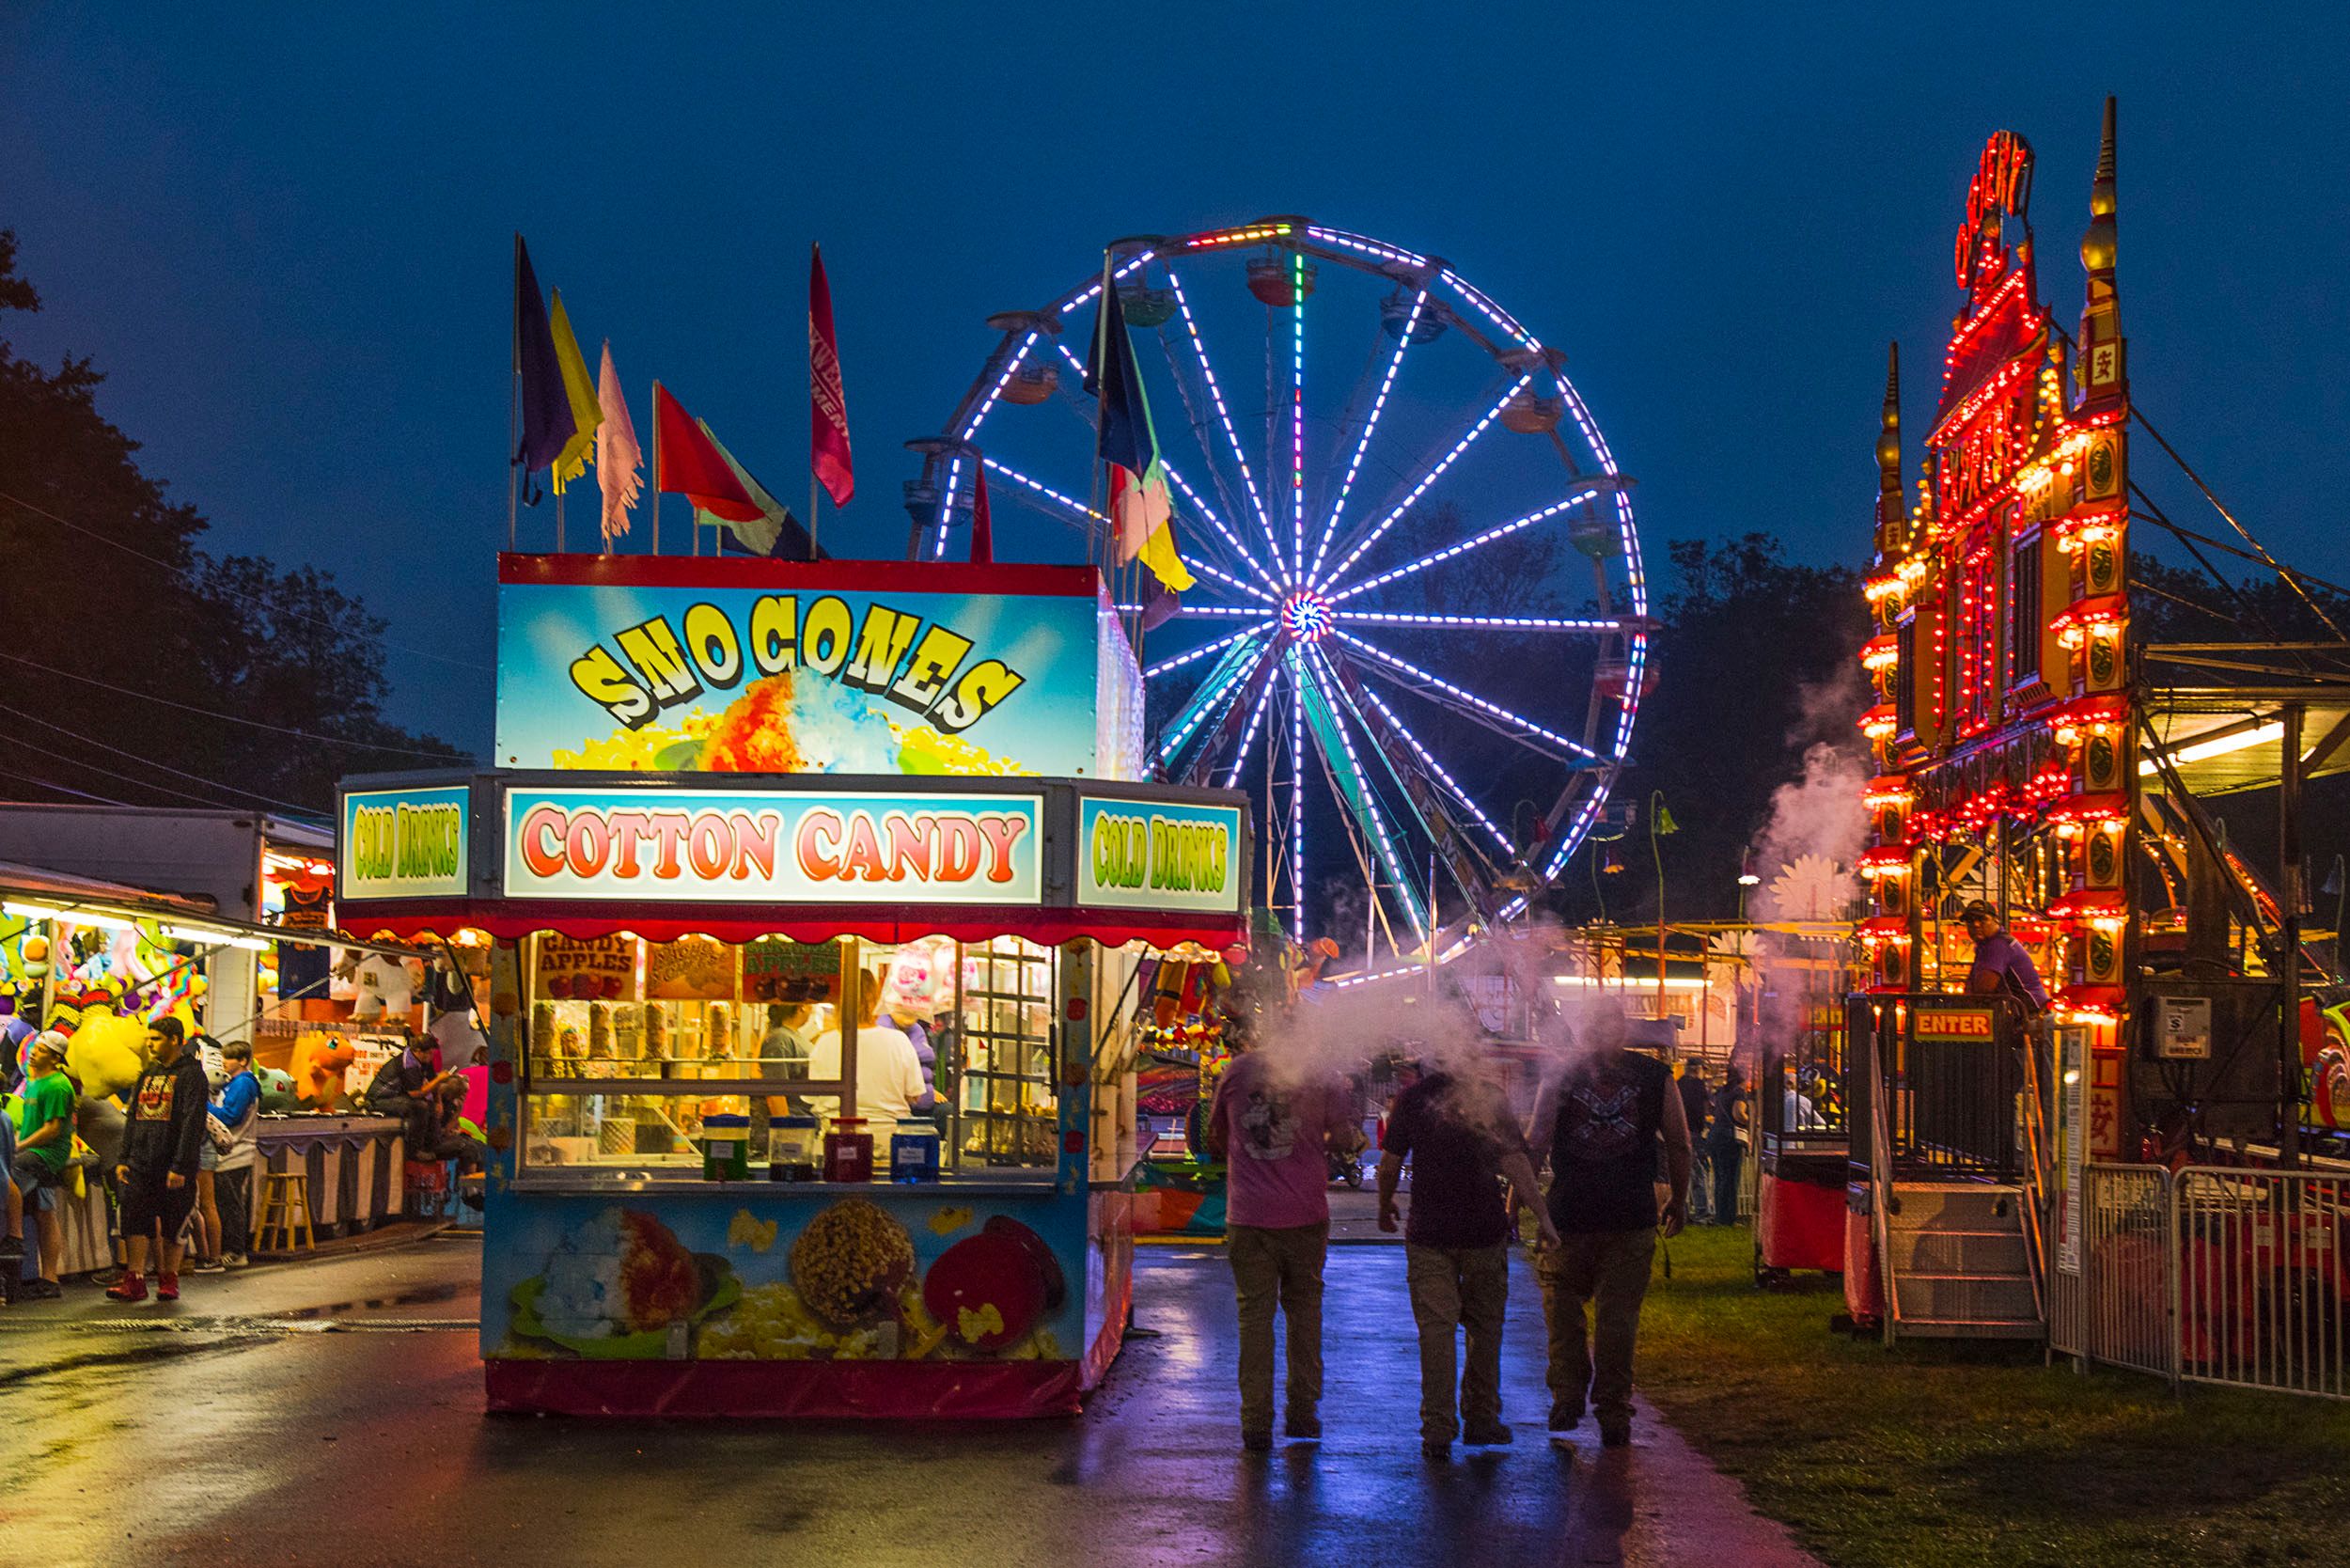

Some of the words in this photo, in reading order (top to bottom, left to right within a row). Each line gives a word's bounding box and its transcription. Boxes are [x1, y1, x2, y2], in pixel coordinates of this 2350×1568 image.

[570, 603, 744, 730] SNO
[748, 594, 1026, 735] CONES
[353, 807, 395, 881] COLD
[398, 807, 460, 879] DRINKS
[523, 808, 776, 882] COTTON
[797, 810, 1026, 884] CANDY
[1092, 815, 1147, 887] COLD
[1150, 819, 1227, 893] DRINKS
[540, 953, 633, 972] APPLES
[1918, 1014, 1990, 1035] ENTER
